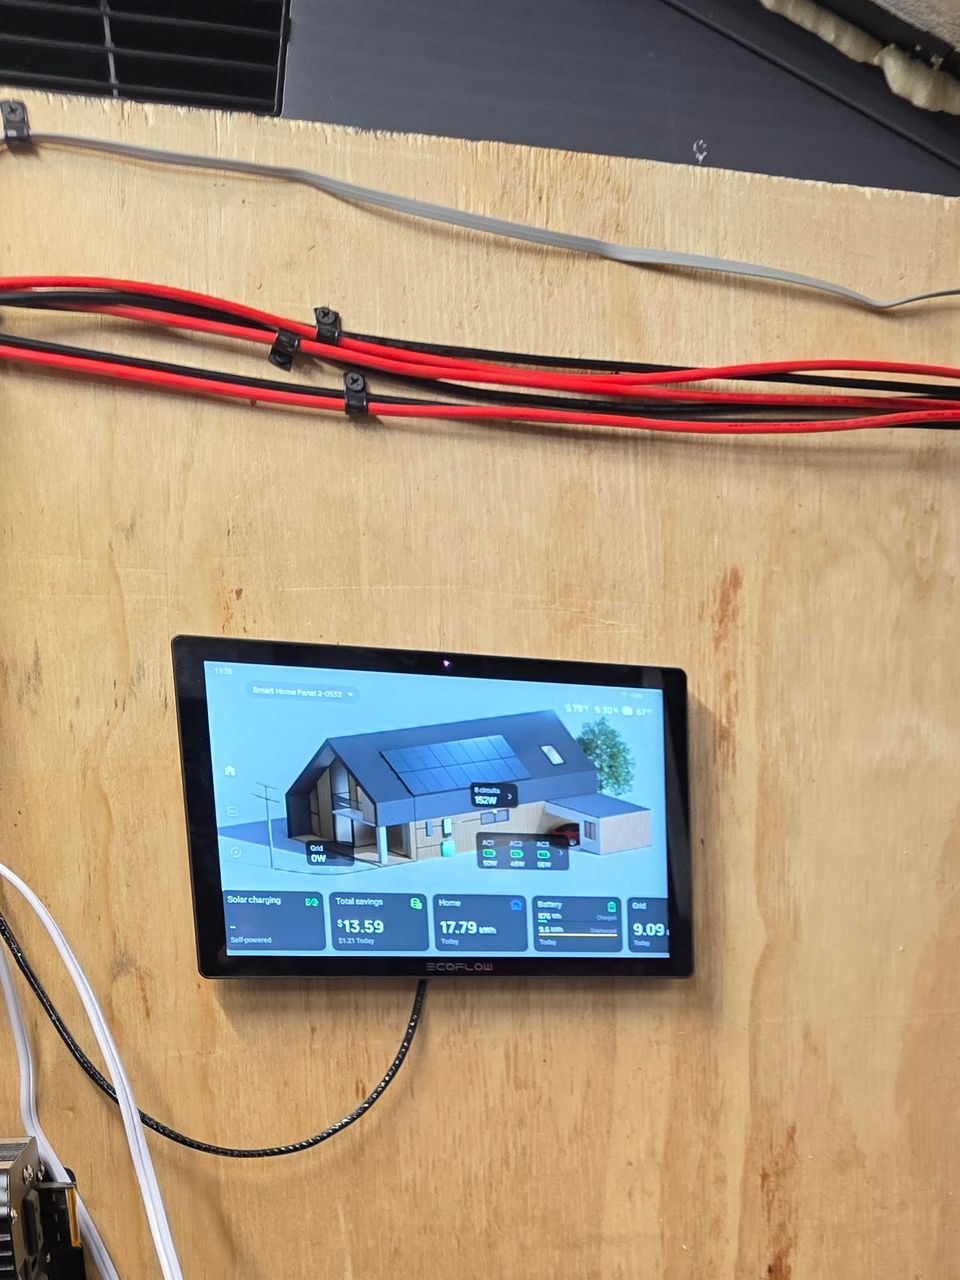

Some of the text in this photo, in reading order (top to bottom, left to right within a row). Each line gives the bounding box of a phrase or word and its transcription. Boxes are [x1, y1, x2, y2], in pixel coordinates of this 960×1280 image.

[253, 686, 274, 695] Smart
[275, 687, 296, 696] Home
[297, 688, 317, 697] Panel
[474, 796, 497, 805] 152W
[310, 844, 324, 852] Grid
[311, 854, 326, 863] 0W
[227, 895, 281, 905] Solar charging
[336, 897, 355, 905] Total
[438, 899, 461, 907] Home
[537, 901, 562, 909] Battery
[632, 902, 647, 910] Grid
[337, 919, 384, 934] $13.59
[440, 920, 497, 934] 17.79 kWh
[633, 923, 665, 936] 9.09
[230, 936, 272, 944] Self-powered
[356, 937, 374, 945] Today
[441, 938, 459, 946] Today
[426, 962, 493, 971] ECOFLOW
